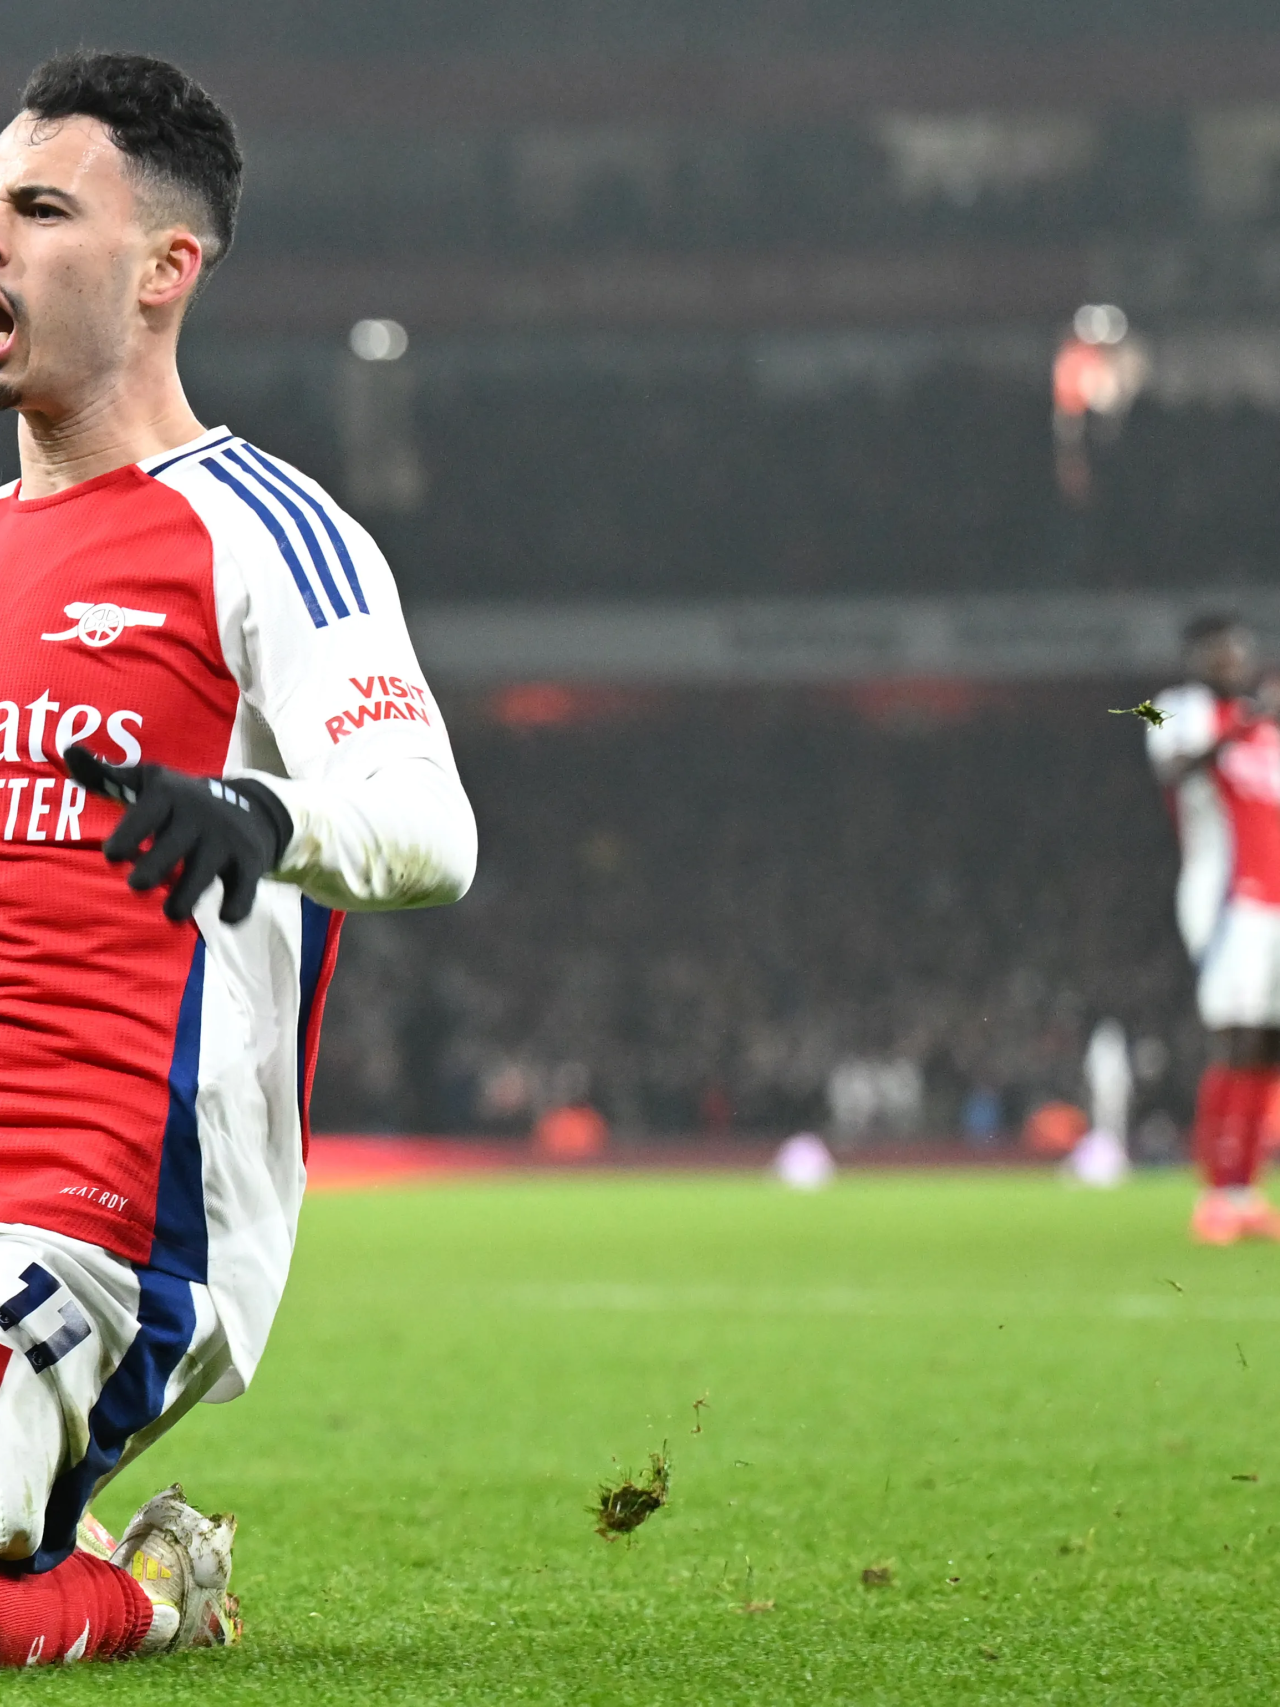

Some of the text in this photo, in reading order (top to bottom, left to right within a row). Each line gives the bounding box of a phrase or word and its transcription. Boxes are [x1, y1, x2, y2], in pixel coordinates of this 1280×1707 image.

[348, 675, 426, 706] VISIT
[324, 700, 431, 745] RWAN
[59, 1186, 129, 1212] HEAT.RDY
